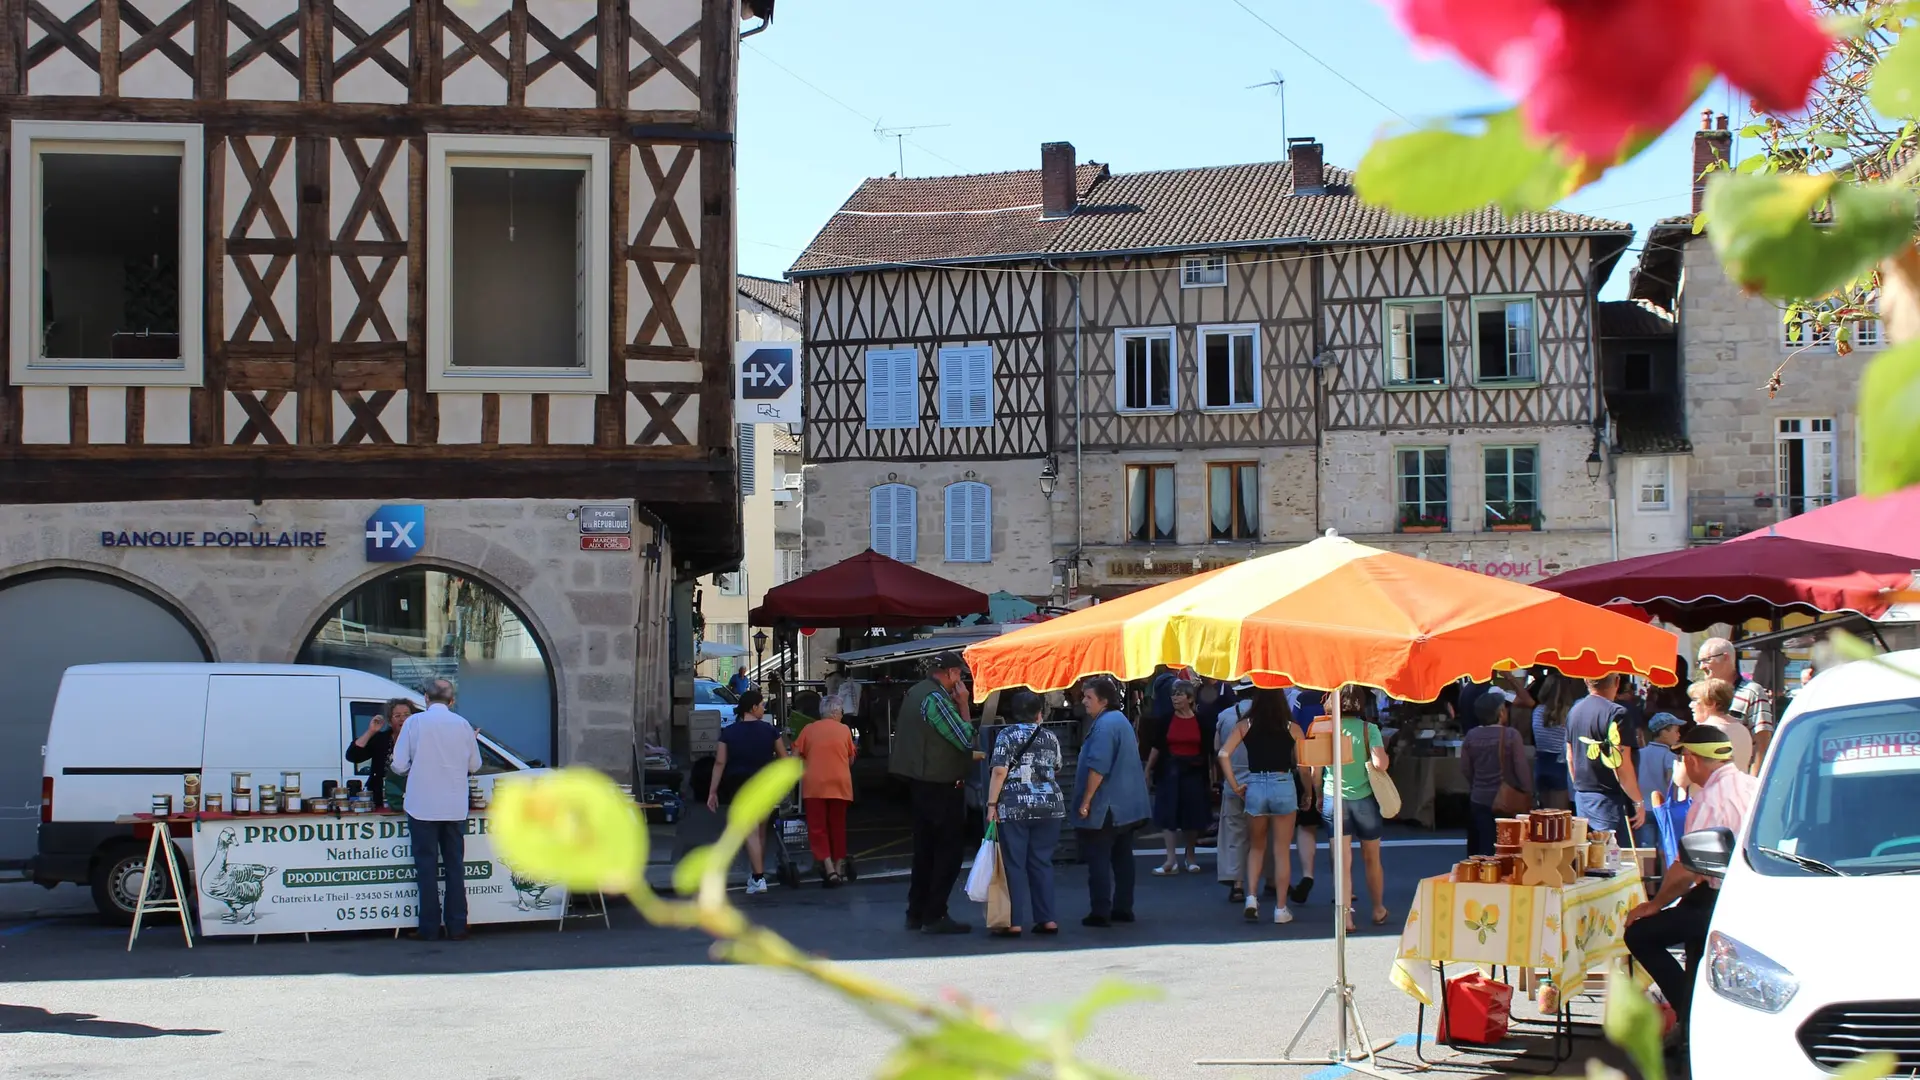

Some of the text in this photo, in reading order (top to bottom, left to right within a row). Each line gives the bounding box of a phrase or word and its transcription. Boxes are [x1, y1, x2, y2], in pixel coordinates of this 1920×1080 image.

[101, 531, 327, 548] BANQUE POPULAIRE
[1111, 562, 1124, 575] LA
[1833, 744, 1920, 762] ABEILLES
[244, 821, 375, 844] PRODUITS
[379, 821, 410, 839] DE
[326, 845, 389, 861] Nathalie
[287, 869, 377, 884] PRODUCTRICE
[378, 869, 395, 881] DE
[463, 864, 489, 877] RAS
[271, 892, 312, 904] Chatreix
[313, 893, 325, 902] Le
[326, 892, 349, 902] Theil
[355, 891, 382, 901] 23430
[383, 890, 393, 899] St
[394, 889, 418, 899] MAR
[336, 907, 356, 921] 05
[360, 906, 378, 919] 55
[381, 905, 399, 919] 64
